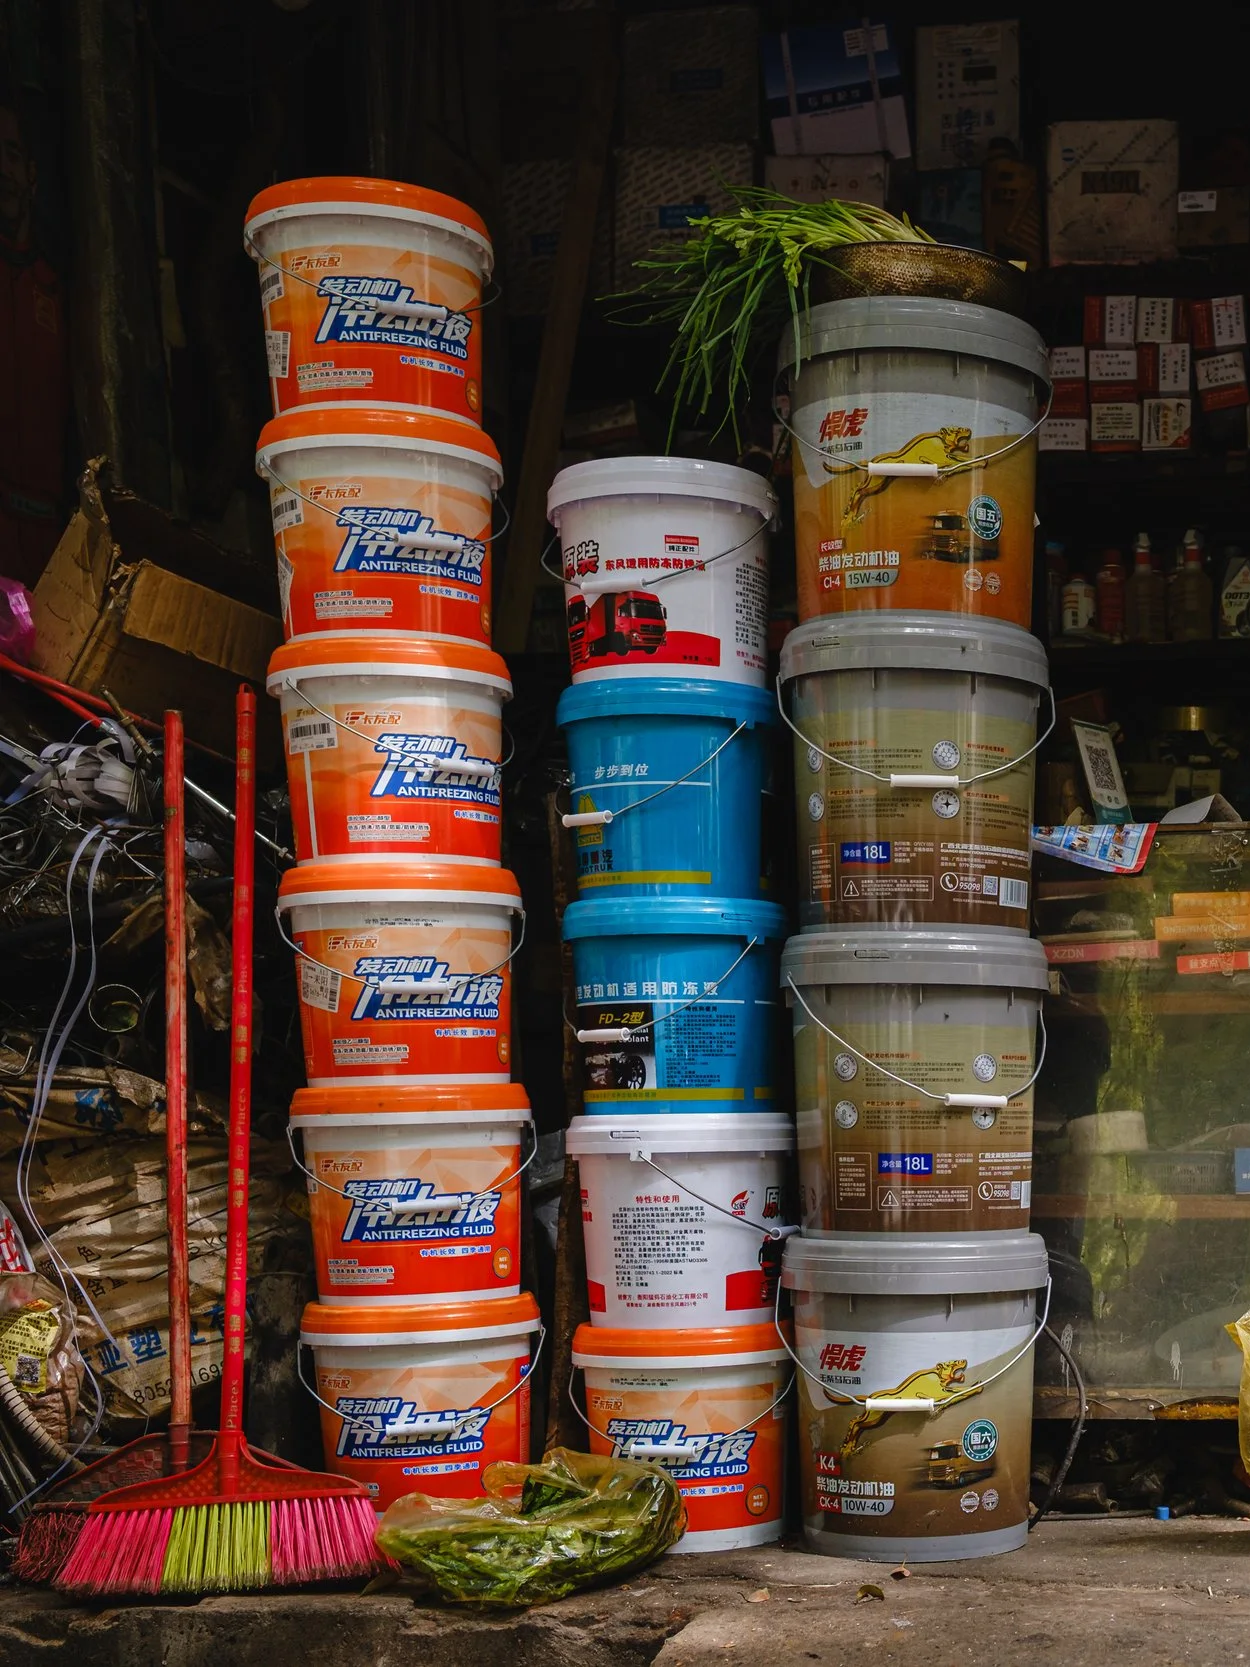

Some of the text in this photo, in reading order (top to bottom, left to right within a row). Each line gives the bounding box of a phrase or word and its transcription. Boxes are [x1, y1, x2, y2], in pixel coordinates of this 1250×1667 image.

[319, 278, 398, 296] 发动机
[339, 330, 468, 360] ANTIFREEZING FLUID
[819, 407, 868, 443] 悍虎
[339, 509, 418, 527] 发动机
[976, 507, 996, 522] 国五
[820, 539, 843, 552] 长效型
[818, 550, 900, 573] 柴油发动机油
[359, 560, 482, 585] ANTIFREEZING FLUID
[823, 571, 890, 589] CI-4 15W-40
[377, 735, 452, 753] 发动机
[594, 763, 649, 780] 步步到位
[397, 786, 484, 802] ANTIFREEZING
[863, 845, 887, 859] 18L
[959, 882, 981, 891] 95098
[1052, 948, 1085, 960] XZDN
[356, 957, 432, 975] 发动机
[376, 1007, 499, 1018] ANTIFREEZING FLUID
[599, 1010, 645, 1025] FD-2型
[881, 1156, 930, 1171] 净含量 18L
[345, 1180, 417, 1196] 发动机
[993, 1189, 1010, 1199] 95098
[635, 1195, 680, 1205] 特性和使用
[362, 1224, 495, 1241] ANTIFREEZING FLUID
[231, 1230, 244, 1281] Places
[819, 1343, 867, 1372] 悍虎
[819, 1373, 862, 1385] 玉柴马石油
[225, 1378, 241, 1430] Places
[336, 1399, 400, 1414] 发动机
[608, 1421, 670, 1435] 发动机
[970, 1431, 992, 1445] 国六
[351, 1440, 483, 1457] ANTIFREEZING FLUID
[713, 1463, 748, 1475] FLUID
[819, 1454, 836, 1472] K4
[679, 1487, 706, 1496] 机长效
[816, 1476, 895, 1497] 柴油发动机油
[819, 1496, 886, 1513] CK-4 10W-40
